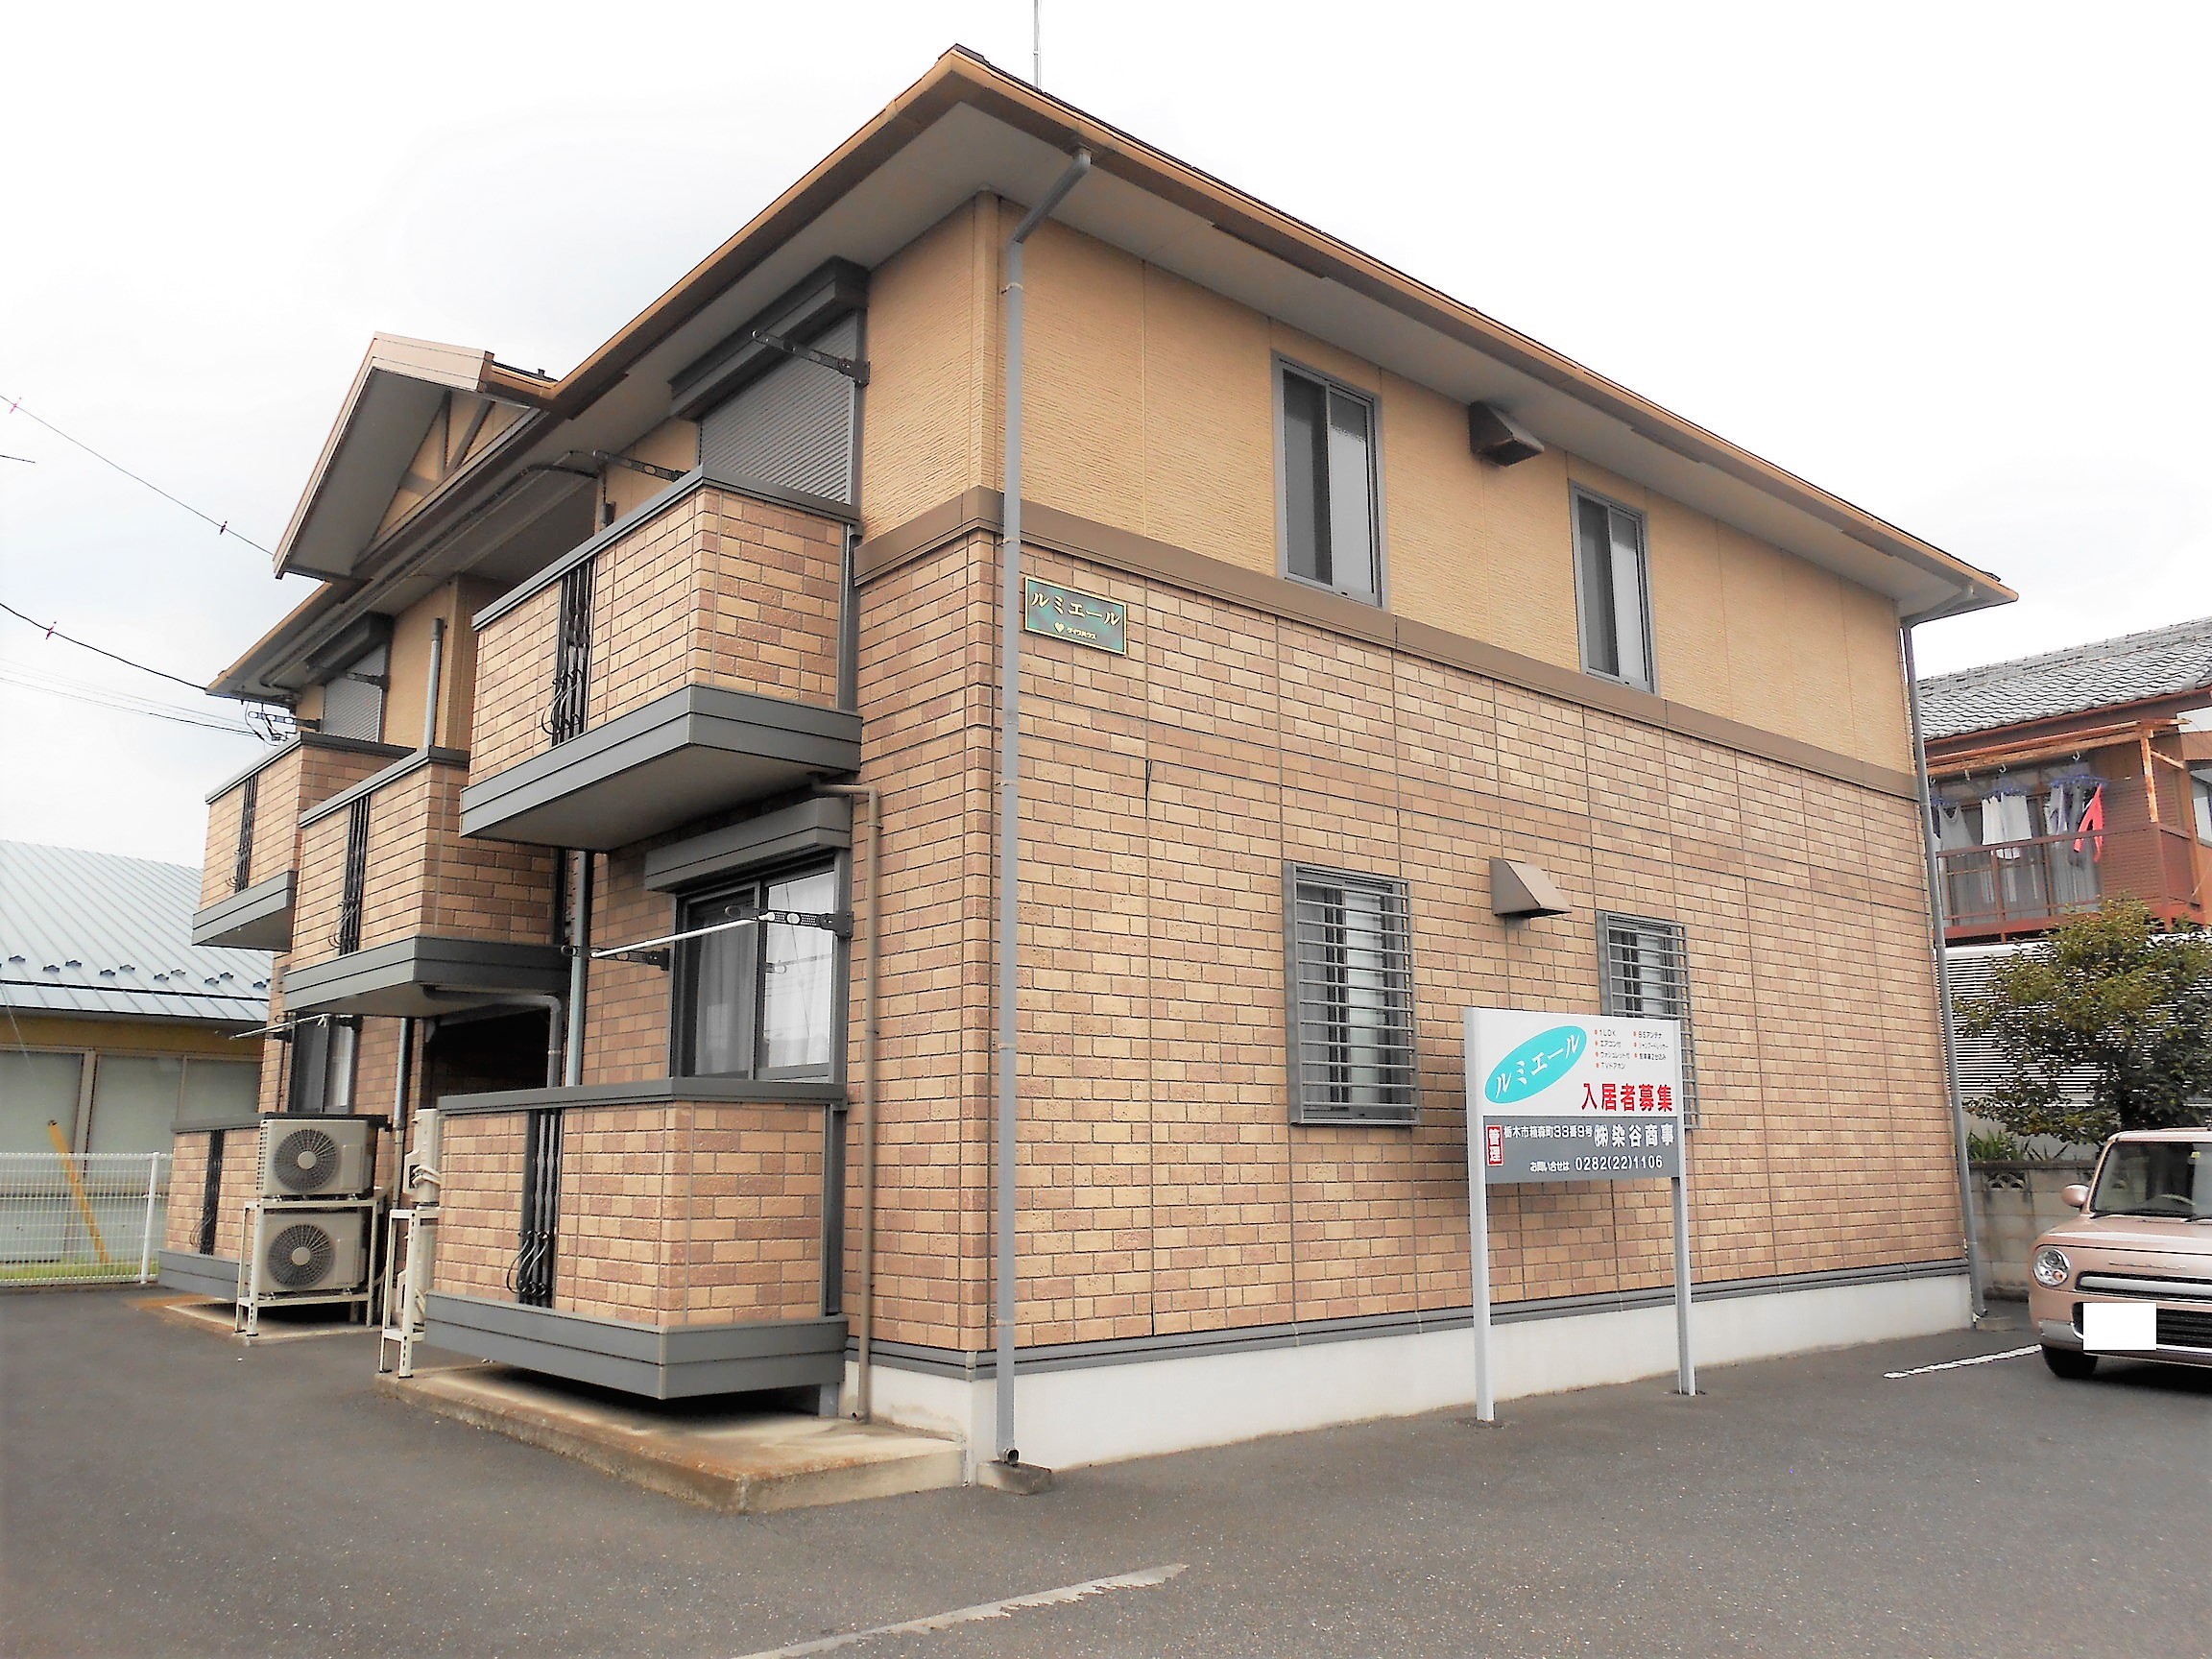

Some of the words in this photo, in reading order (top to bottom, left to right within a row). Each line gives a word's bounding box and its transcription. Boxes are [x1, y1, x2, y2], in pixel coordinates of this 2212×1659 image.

[1031, 592, 1120, 626] ルミエール
[1495, 1034, 1581, 1099] ルミエール
[1581, 1082, 1673, 1113] 入居者募集
[1488, 1128, 1502, 1163] 管理
[1575, 1154, 1664, 1172] 0282(22)1106
